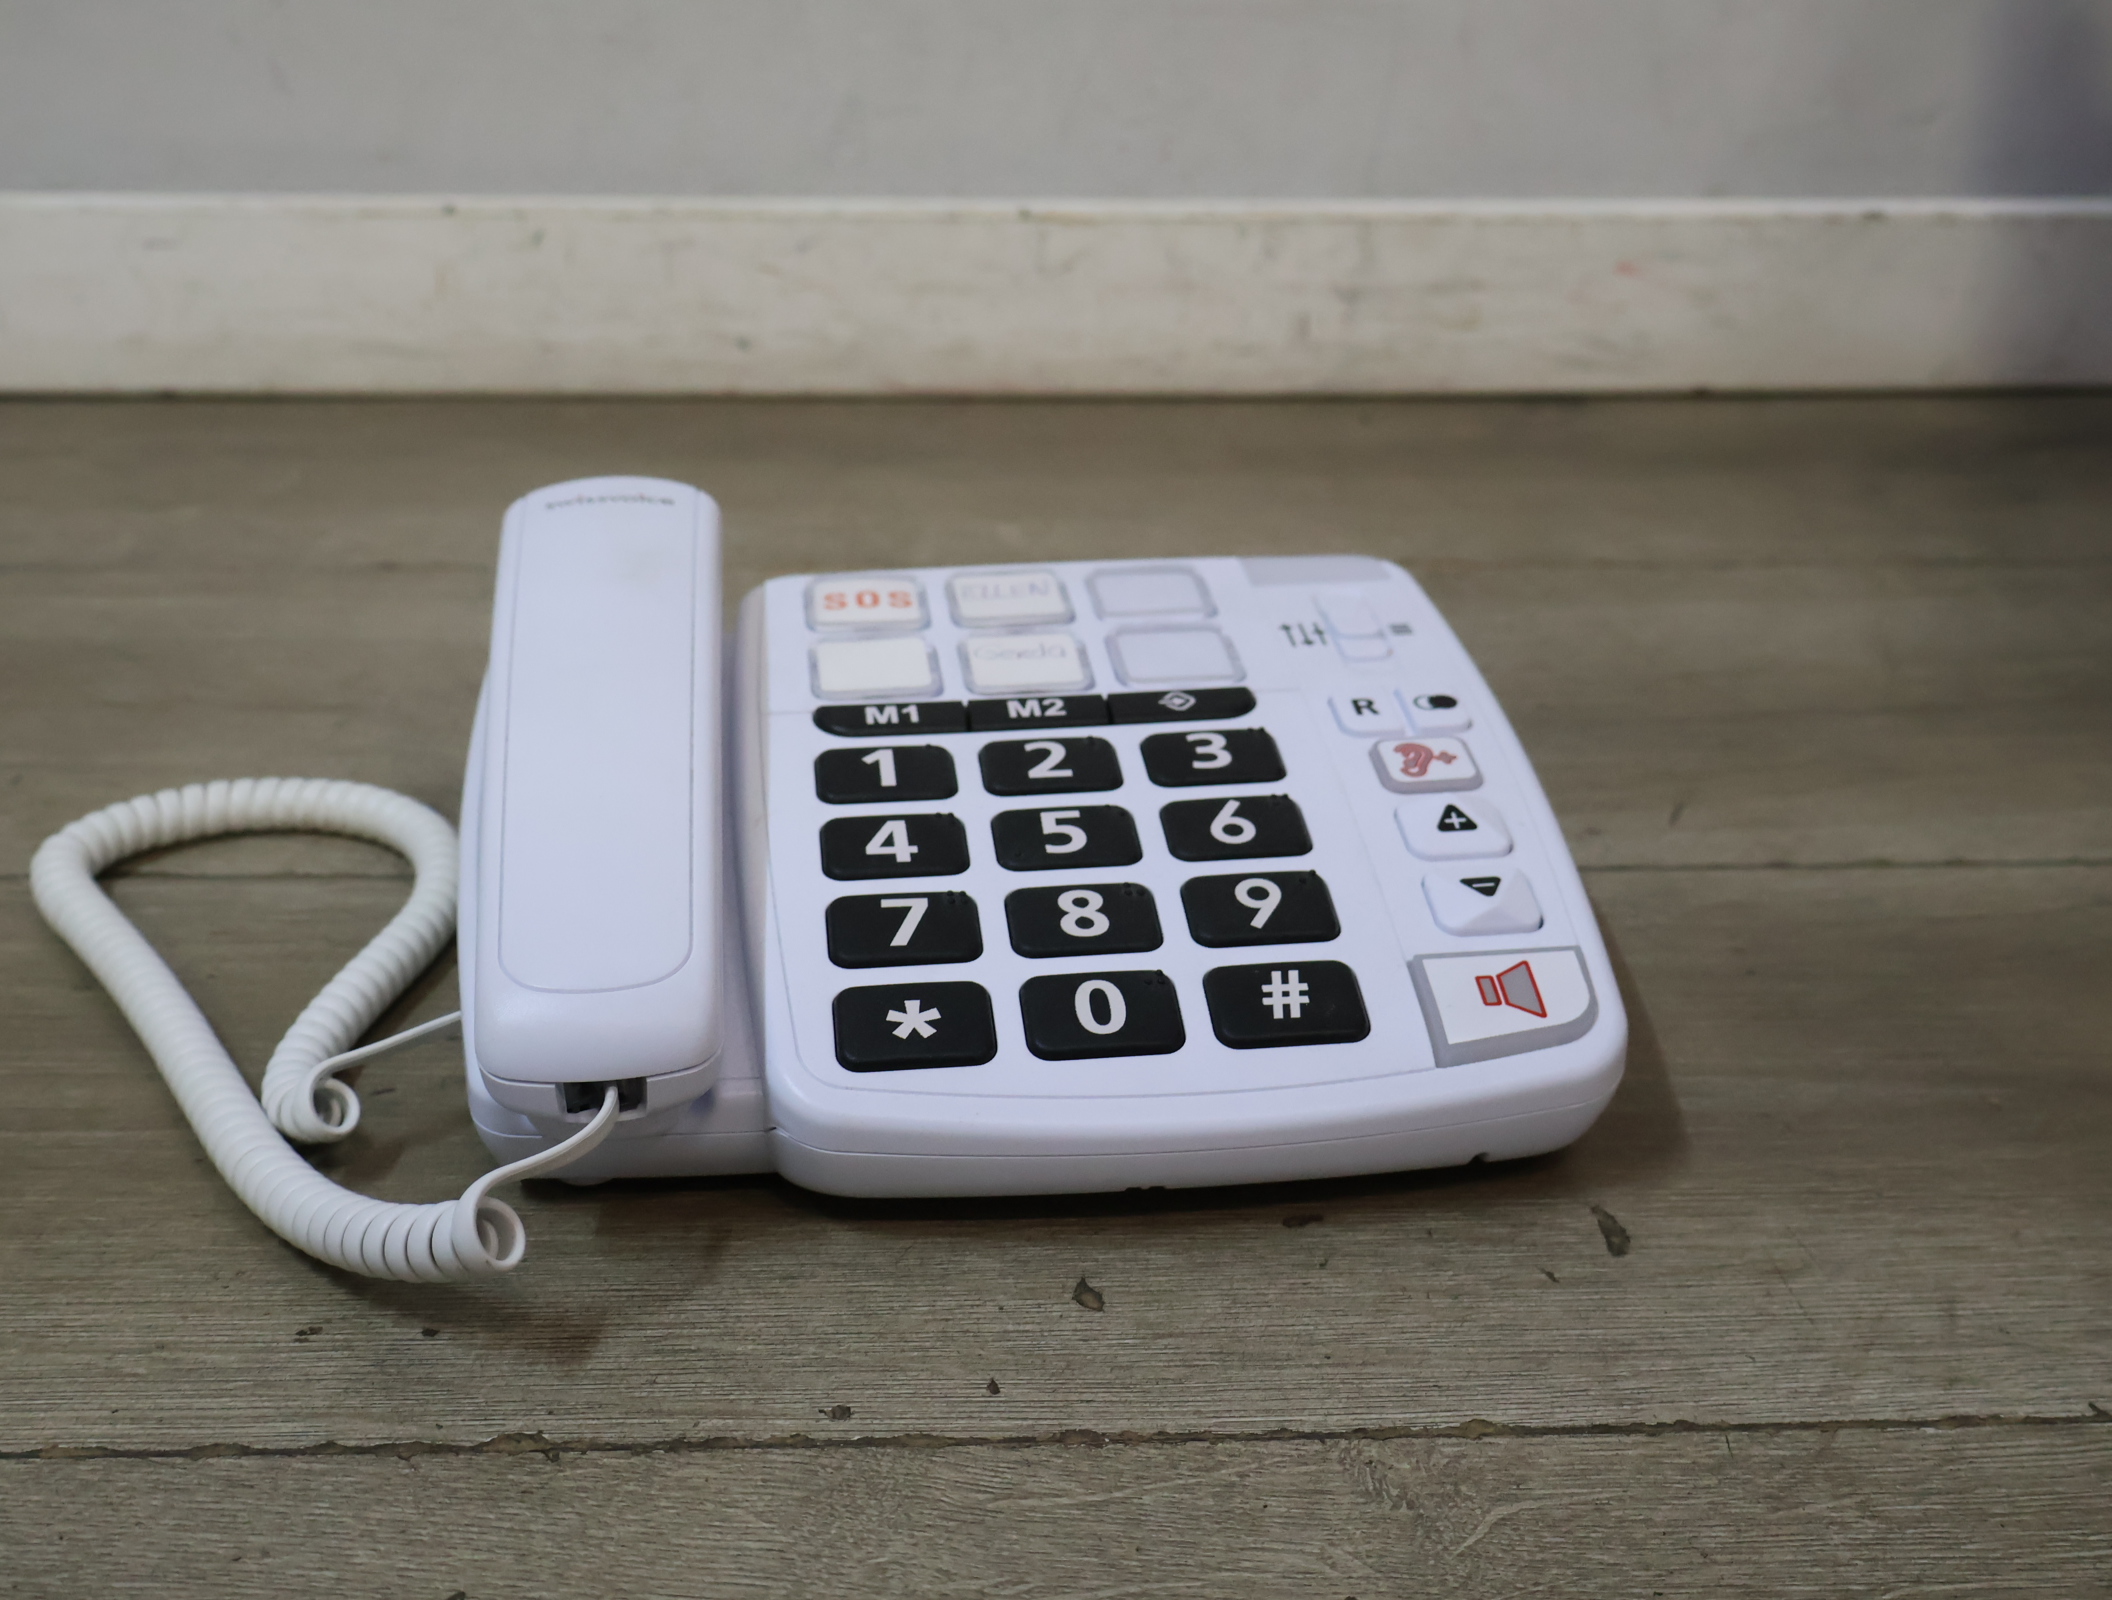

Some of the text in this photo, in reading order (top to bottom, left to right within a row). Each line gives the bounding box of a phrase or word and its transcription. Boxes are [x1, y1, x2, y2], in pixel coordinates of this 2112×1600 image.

[823, 589, 913, 611] SOS
[865, 704, 919, 725] M1
[1006, 697, 1066, 718] M2
[1352, 699, 1379, 716] R
[862, 748, 897, 787] 1
[1024, 741, 1074, 779] 2
[1188, 732, 1233, 770] 3
[865, 819, 919, 863] 4
[1040, 810, 1087, 854] 5
[1210, 799, 1256, 845] 6
[880, 897, 929, 947] 7
[1057, 889, 1110, 937] 8
[1234, 878, 1282, 929] 9
[1074, 979, 1127, 1035] 0
[1261, 969, 1310, 1019] #
